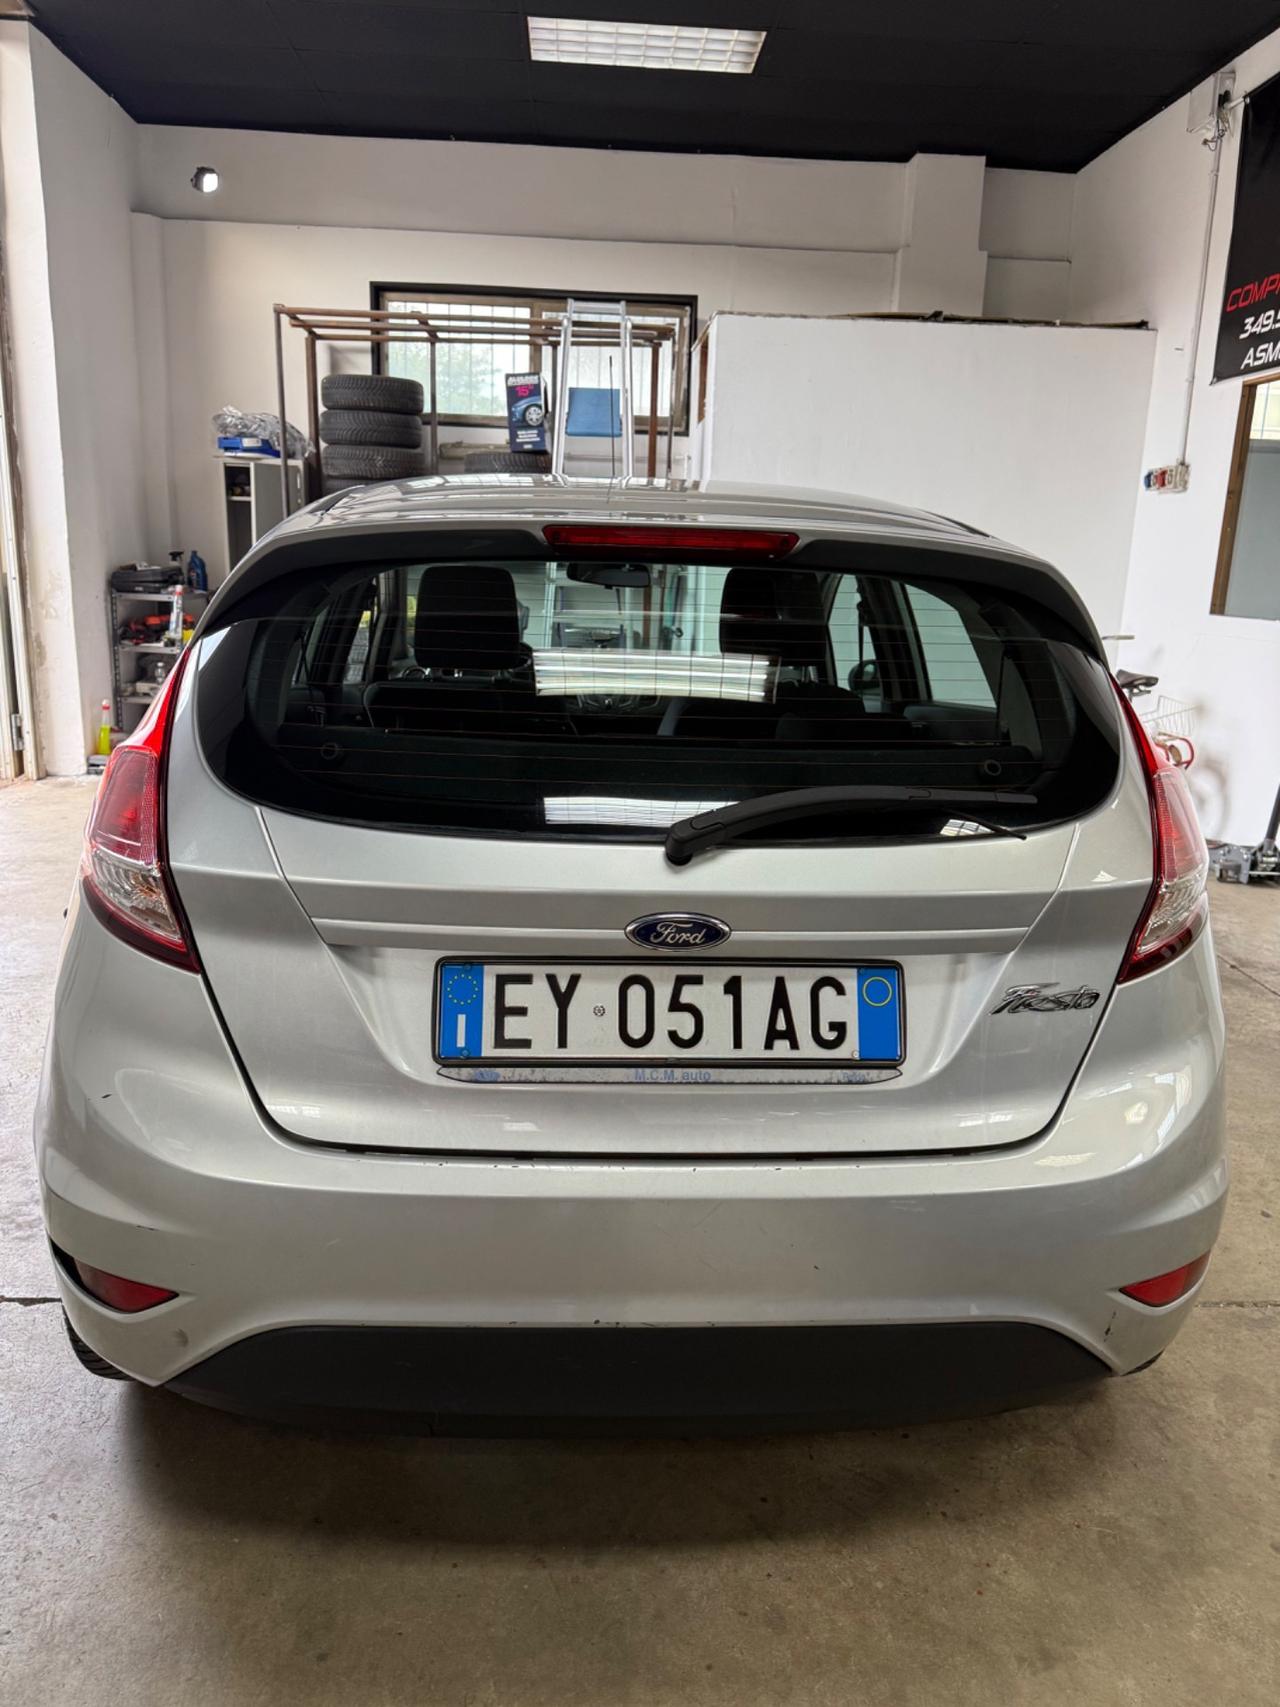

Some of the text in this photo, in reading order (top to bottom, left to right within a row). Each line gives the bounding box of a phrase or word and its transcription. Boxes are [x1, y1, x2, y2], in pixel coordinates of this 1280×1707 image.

[1226, 273, 1280, 312] COMP
[1240, 342, 1280, 370] ASM
[650, 921, 707, 944] Ford
[493, 973, 847, 1050] EY 051AG
[635, 1069, 711, 1081] M.C.M. auto
